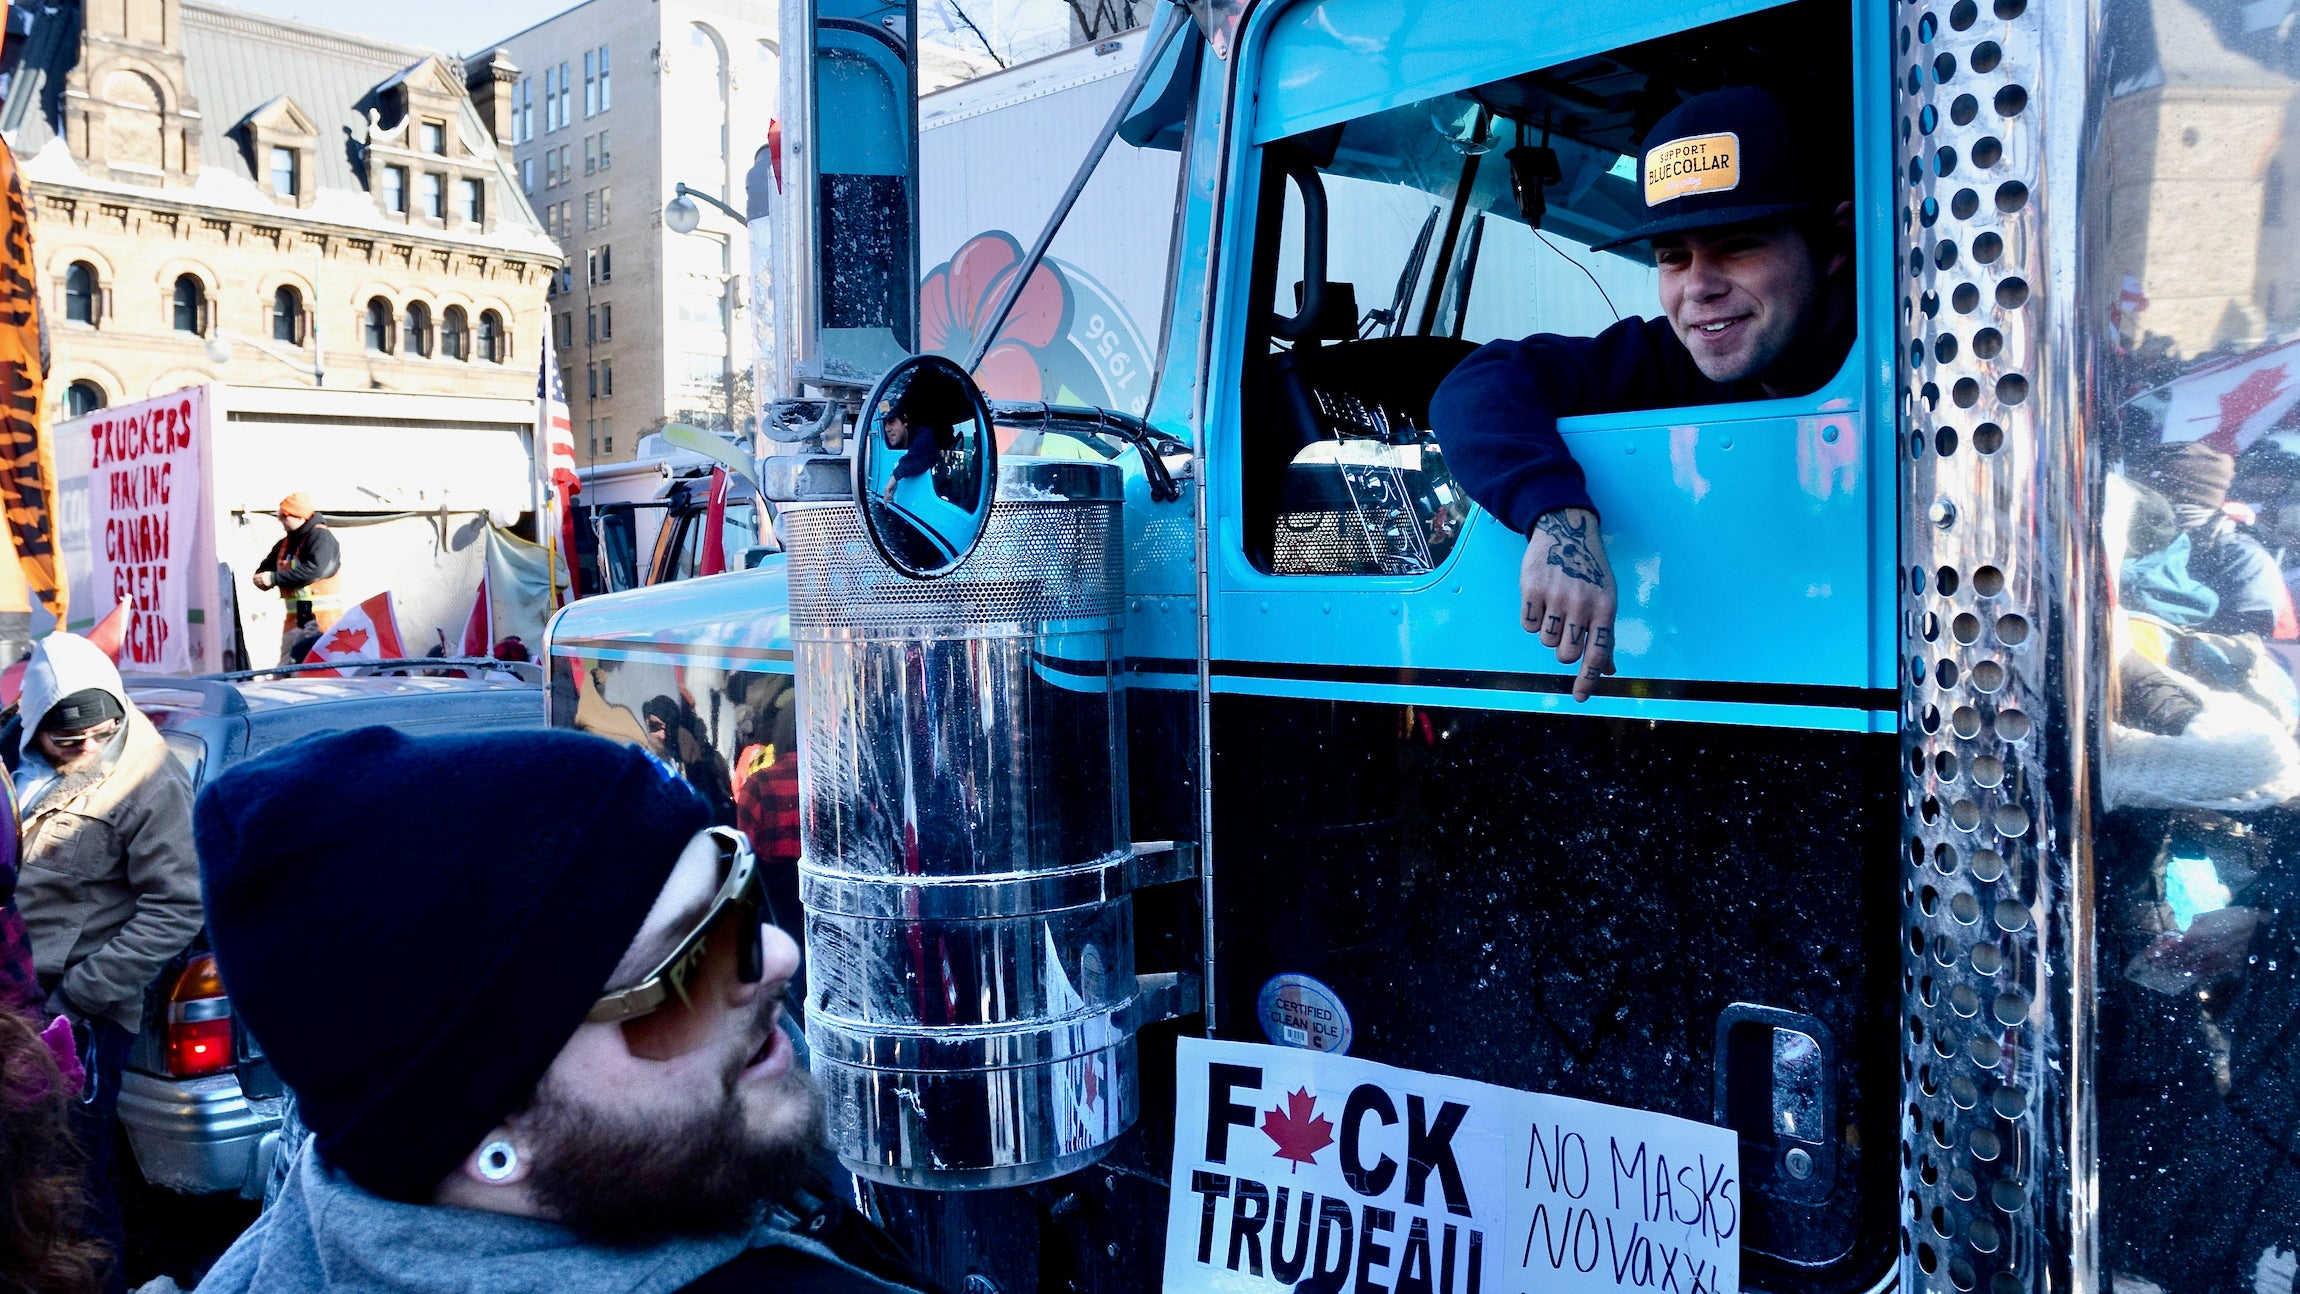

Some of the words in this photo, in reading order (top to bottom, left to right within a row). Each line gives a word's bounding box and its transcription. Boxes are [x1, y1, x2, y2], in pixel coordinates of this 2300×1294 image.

[1659, 143, 1708, 163] SUPPORT
[1084, 313, 1137, 391] 1956
[91, 399, 191, 469] TRUCKERS
[1525, 601, 1611, 649] LIVE
[1270, 1011, 1308, 1031] CLEAN
[1312, 1022, 1339, 1038] IDLE
[1275, 998, 1332, 1022] CERTIFIED
[1525, 1122, 1590, 1200] NO
[1191, 1169, 1484, 1294] TRUDEAU
